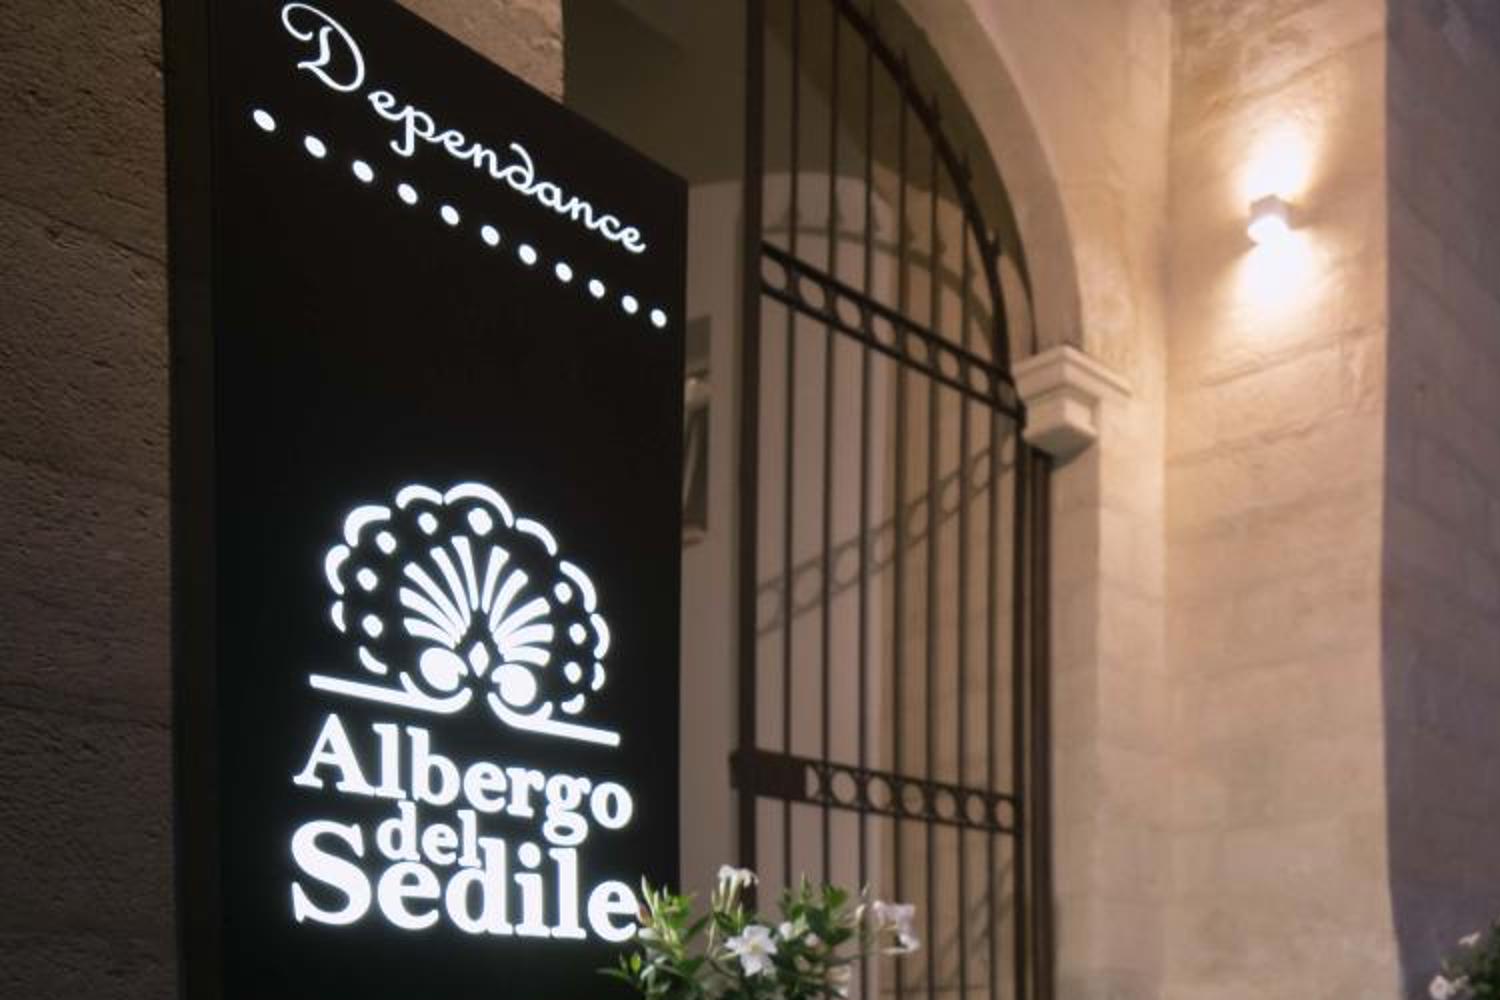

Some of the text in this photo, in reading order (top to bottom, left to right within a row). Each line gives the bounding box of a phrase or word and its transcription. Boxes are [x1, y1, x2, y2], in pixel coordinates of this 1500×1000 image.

[281, 2, 646, 253] Dependance
[293, 713, 634, 846] Albergo
[375, 801, 481, 867] del
[291, 820, 641, 942] Sedile
